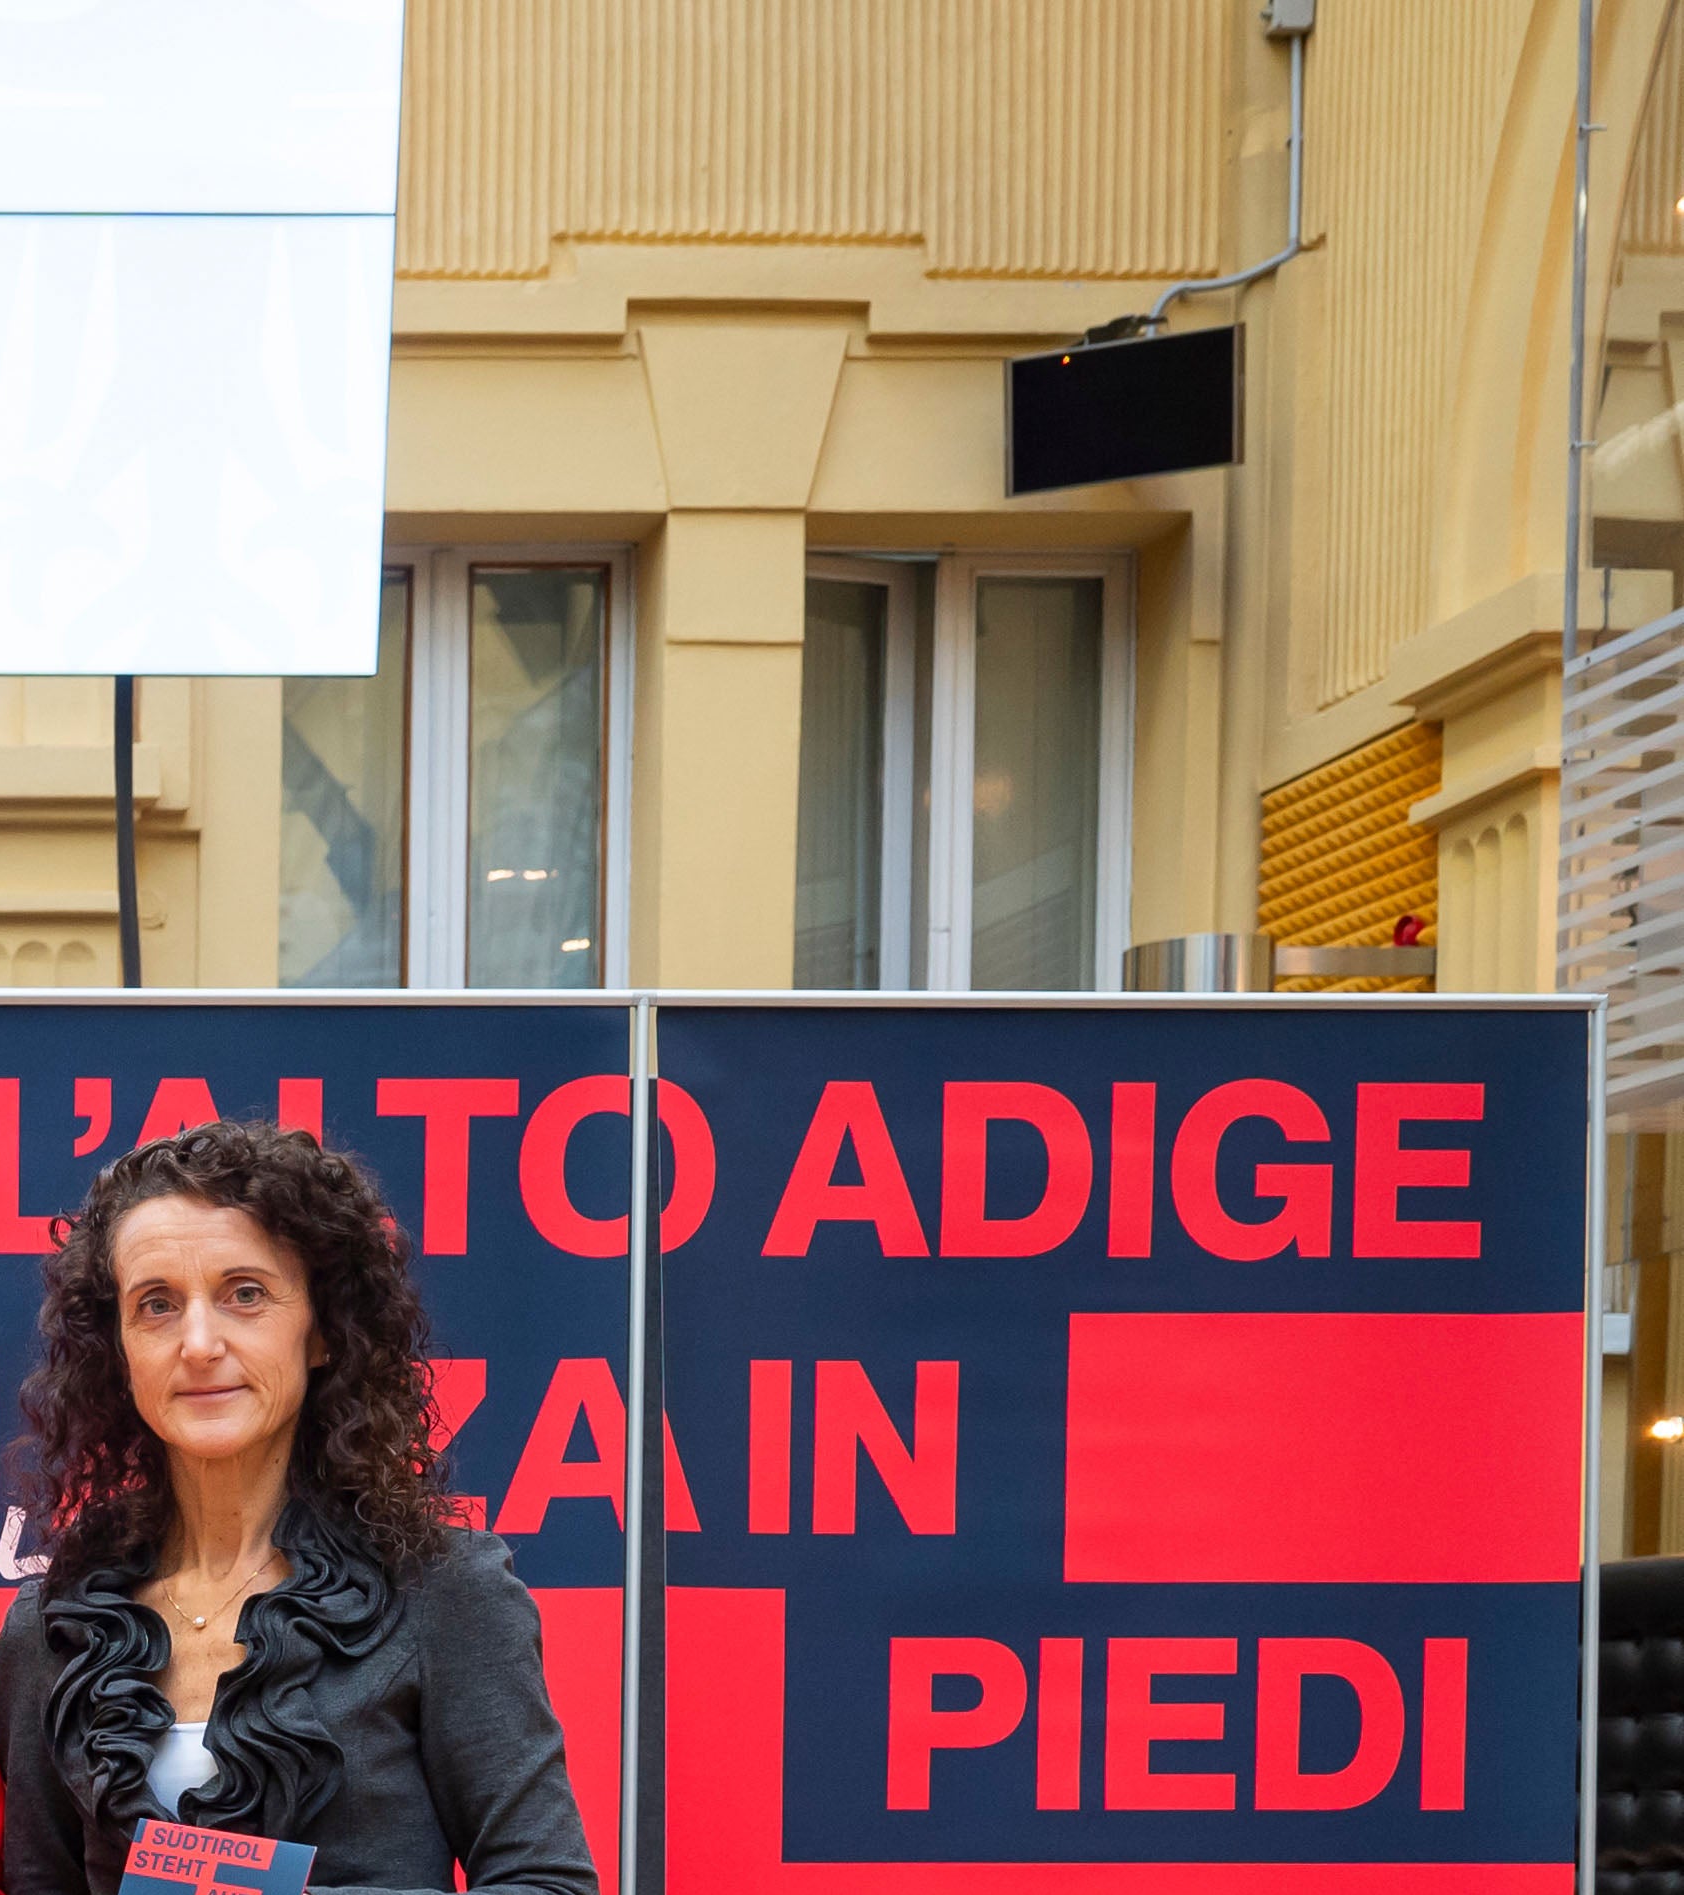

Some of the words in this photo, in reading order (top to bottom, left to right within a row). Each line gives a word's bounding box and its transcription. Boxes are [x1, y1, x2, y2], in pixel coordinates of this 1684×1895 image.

[759, 1076, 1486, 1263] ADIGE
[747, 1358, 960, 1536] IN
[885, 1635, 1469, 1812] PIEDI
[133, 1850, 208, 1878] STEHT
[151, 1825, 263, 1862] SÜDTIROL
